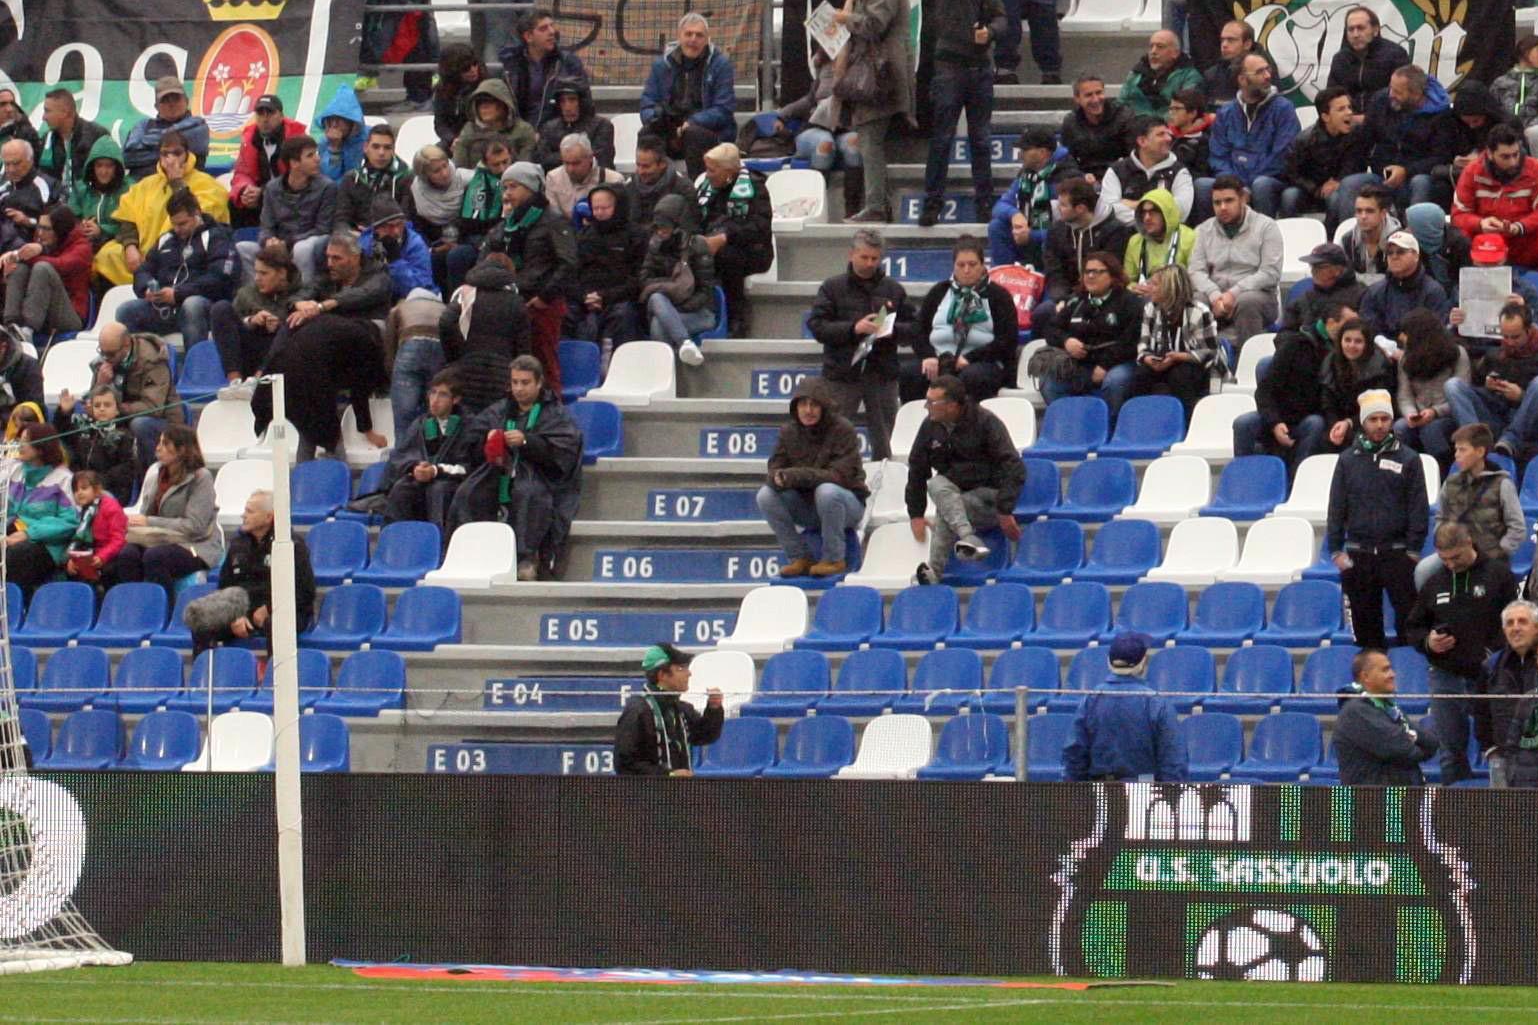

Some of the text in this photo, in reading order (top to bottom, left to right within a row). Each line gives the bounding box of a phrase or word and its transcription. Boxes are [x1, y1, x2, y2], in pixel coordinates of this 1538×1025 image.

[955, 140, 966, 160] E
[908, 199, 920, 220] E
[881, 257, 907, 277] 11
[758, 374, 769, 394] E
[707, 432, 757, 454] E 08
[654, 495, 705, 517] E 07
[602, 556, 779, 578] E 06 F 06
[548, 619, 726, 642] E 05 F 05
[491, 683, 632, 706] E 04 F
[434, 749, 615, 773] E 03 F 03
[1135, 856, 1391, 887] U.S. SASSUOLO
